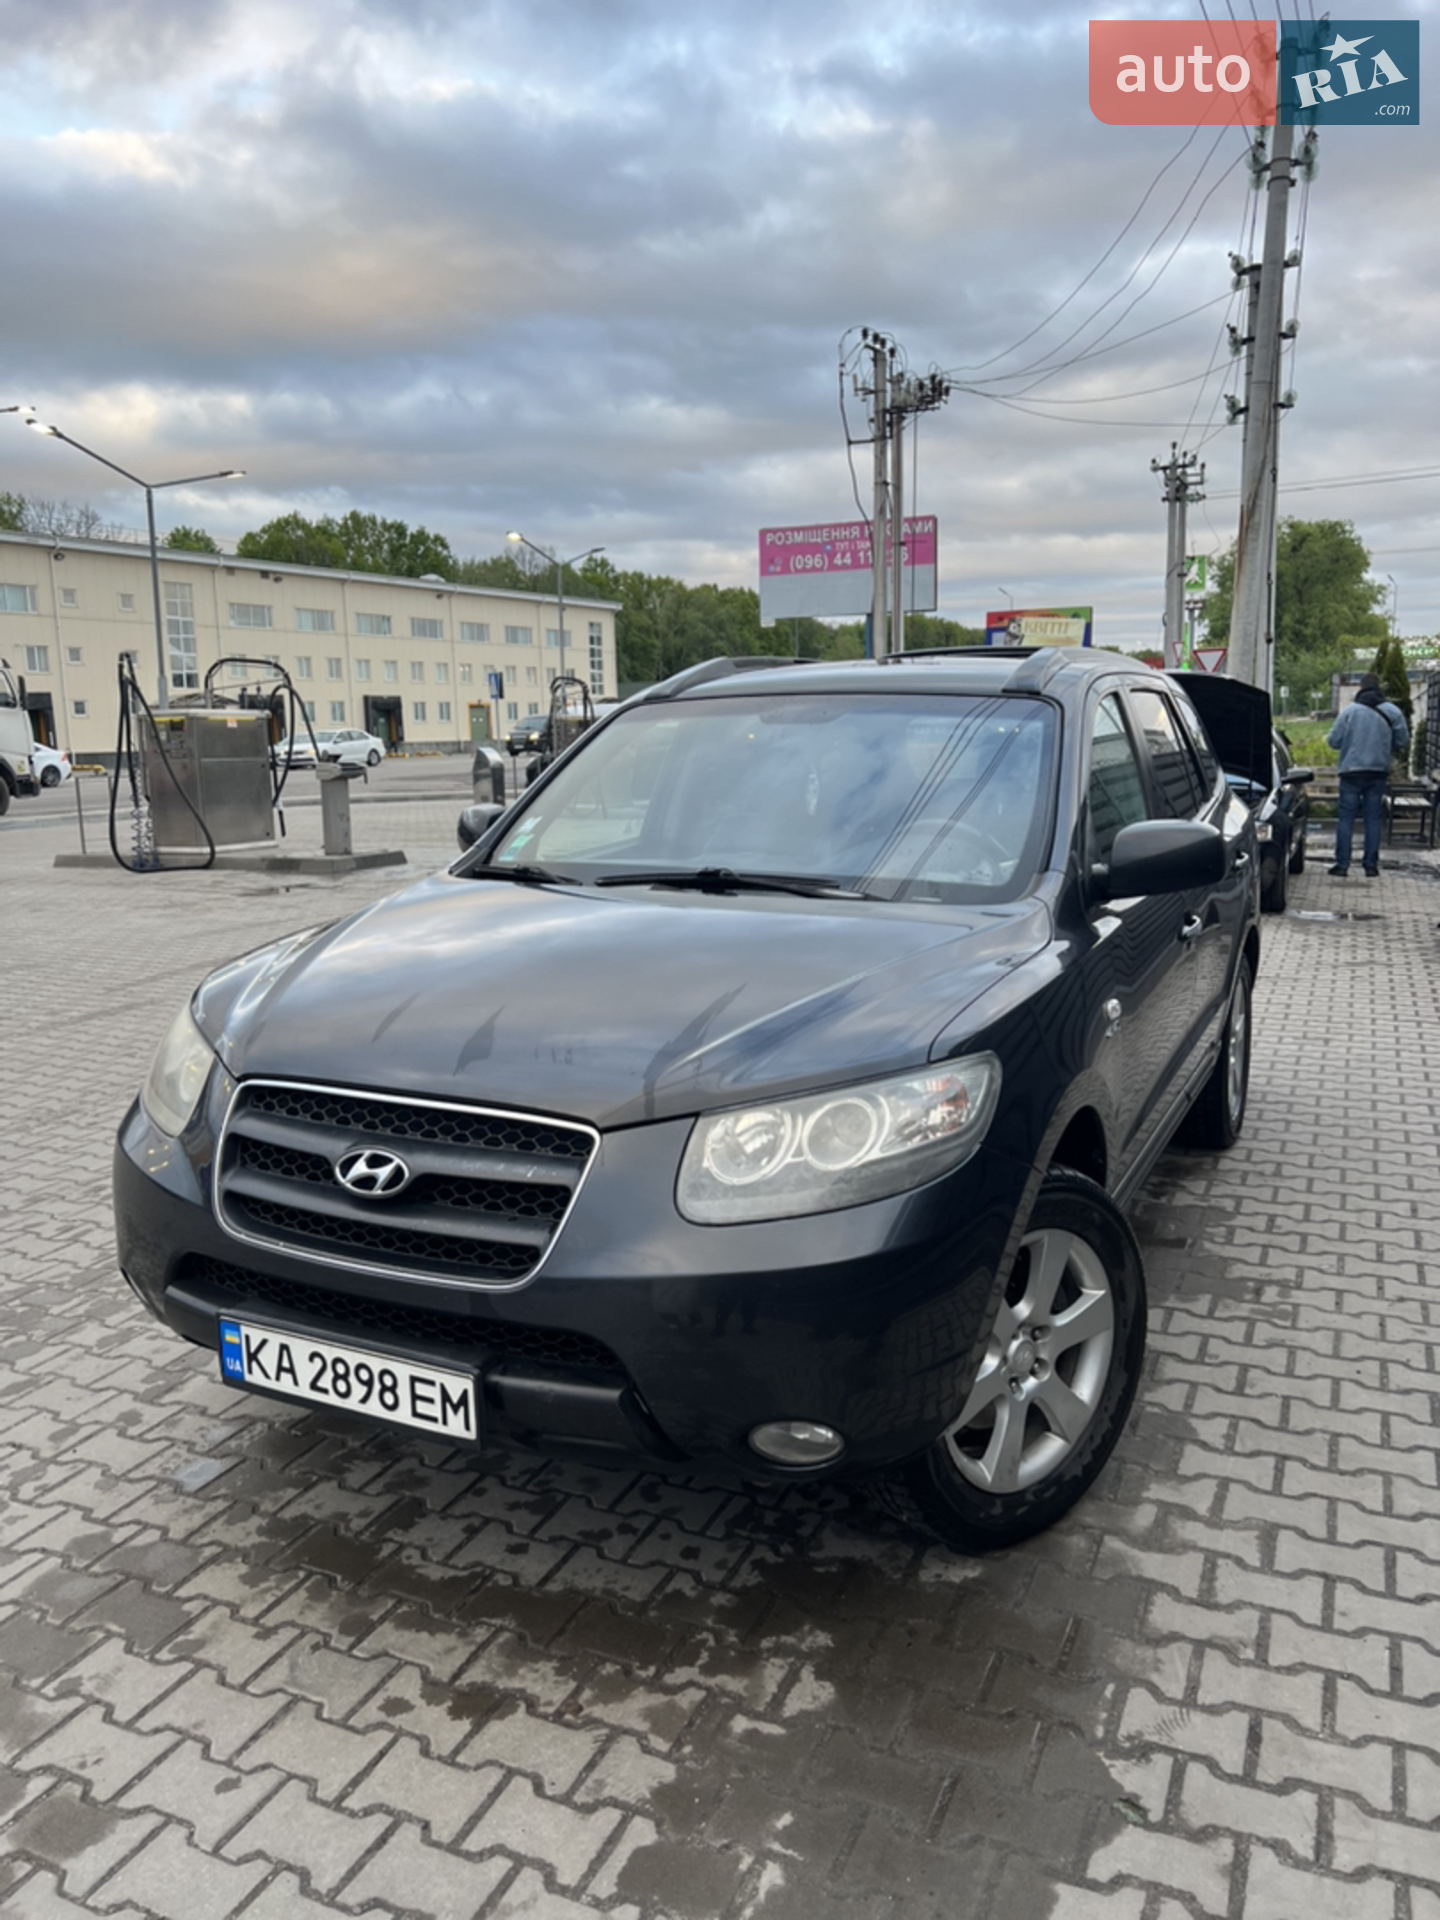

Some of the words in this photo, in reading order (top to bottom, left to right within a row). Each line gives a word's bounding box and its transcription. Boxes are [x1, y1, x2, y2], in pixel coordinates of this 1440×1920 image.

[765, 526, 860, 546] РОЗМІЩЕННЯ
[789, 553, 829, 573] (096)
[834, 551, 851, 566] 44
[226, 1357, 243, 1373] UA
[244, 1334, 299, 1387] KA
[308, 1351, 400, 1412] 2898
[409, 1374, 471, 1432] EM
